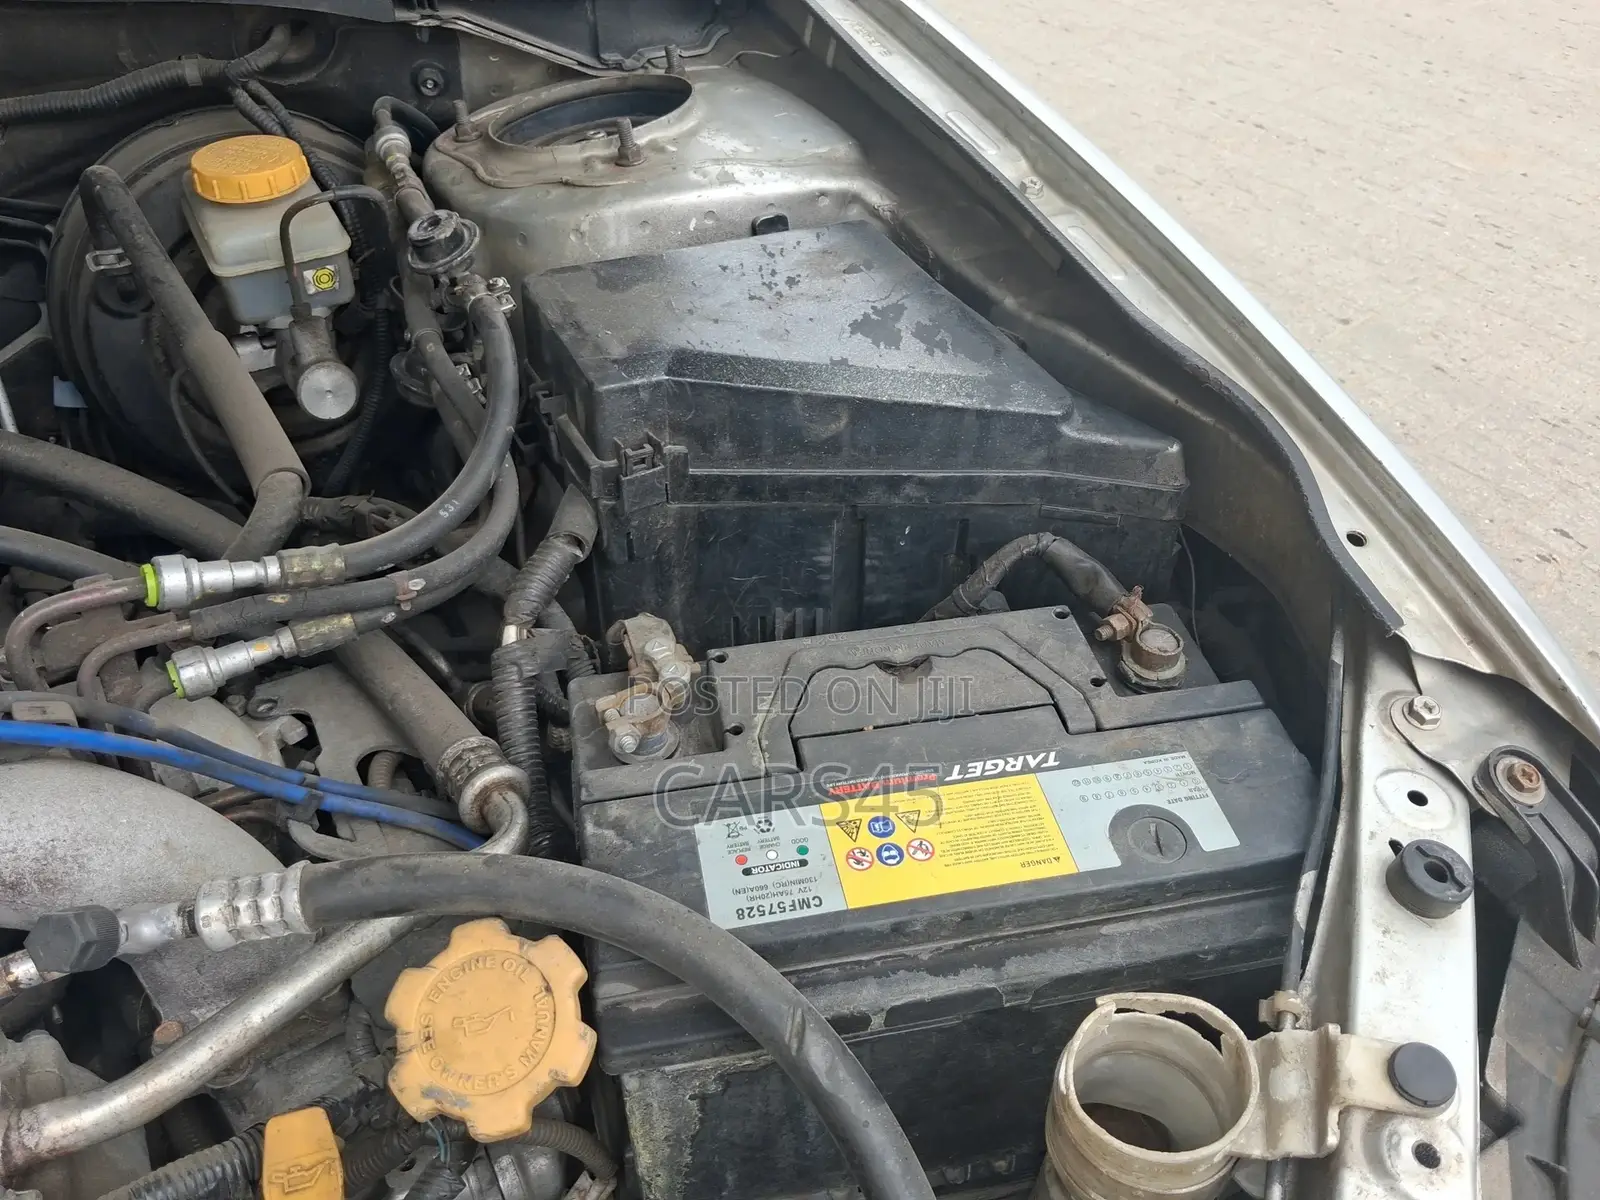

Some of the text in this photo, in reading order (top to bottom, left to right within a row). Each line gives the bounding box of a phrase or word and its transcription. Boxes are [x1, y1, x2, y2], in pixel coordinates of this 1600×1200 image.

[944, 751, 1061, 782] TARGET
[1167, 792, 1209, 805] FITTING DATE
[726, 841, 750, 850] BATTERY
[757, 836, 780, 844] BATTERY
[759, 842, 781, 850] CHARGE
[791, 837, 809, 845] GOOD
[727, 846, 752, 855] REPLACE
[750, 860, 800, 874] INDICATOR
[1020, 857, 1054, 869] DANGER
[732, 876, 818, 895] 130MIN(RC) 660A(EN)
[747, 886, 812, 901] 12V 75AH(20HR)
[736, 896, 823, 920] CMF57528
[428, 955, 529, 1005] ENGINE OIL
[419, 1013, 436, 1055] SEE
[518, 984, 551, 1068] MANUAL
